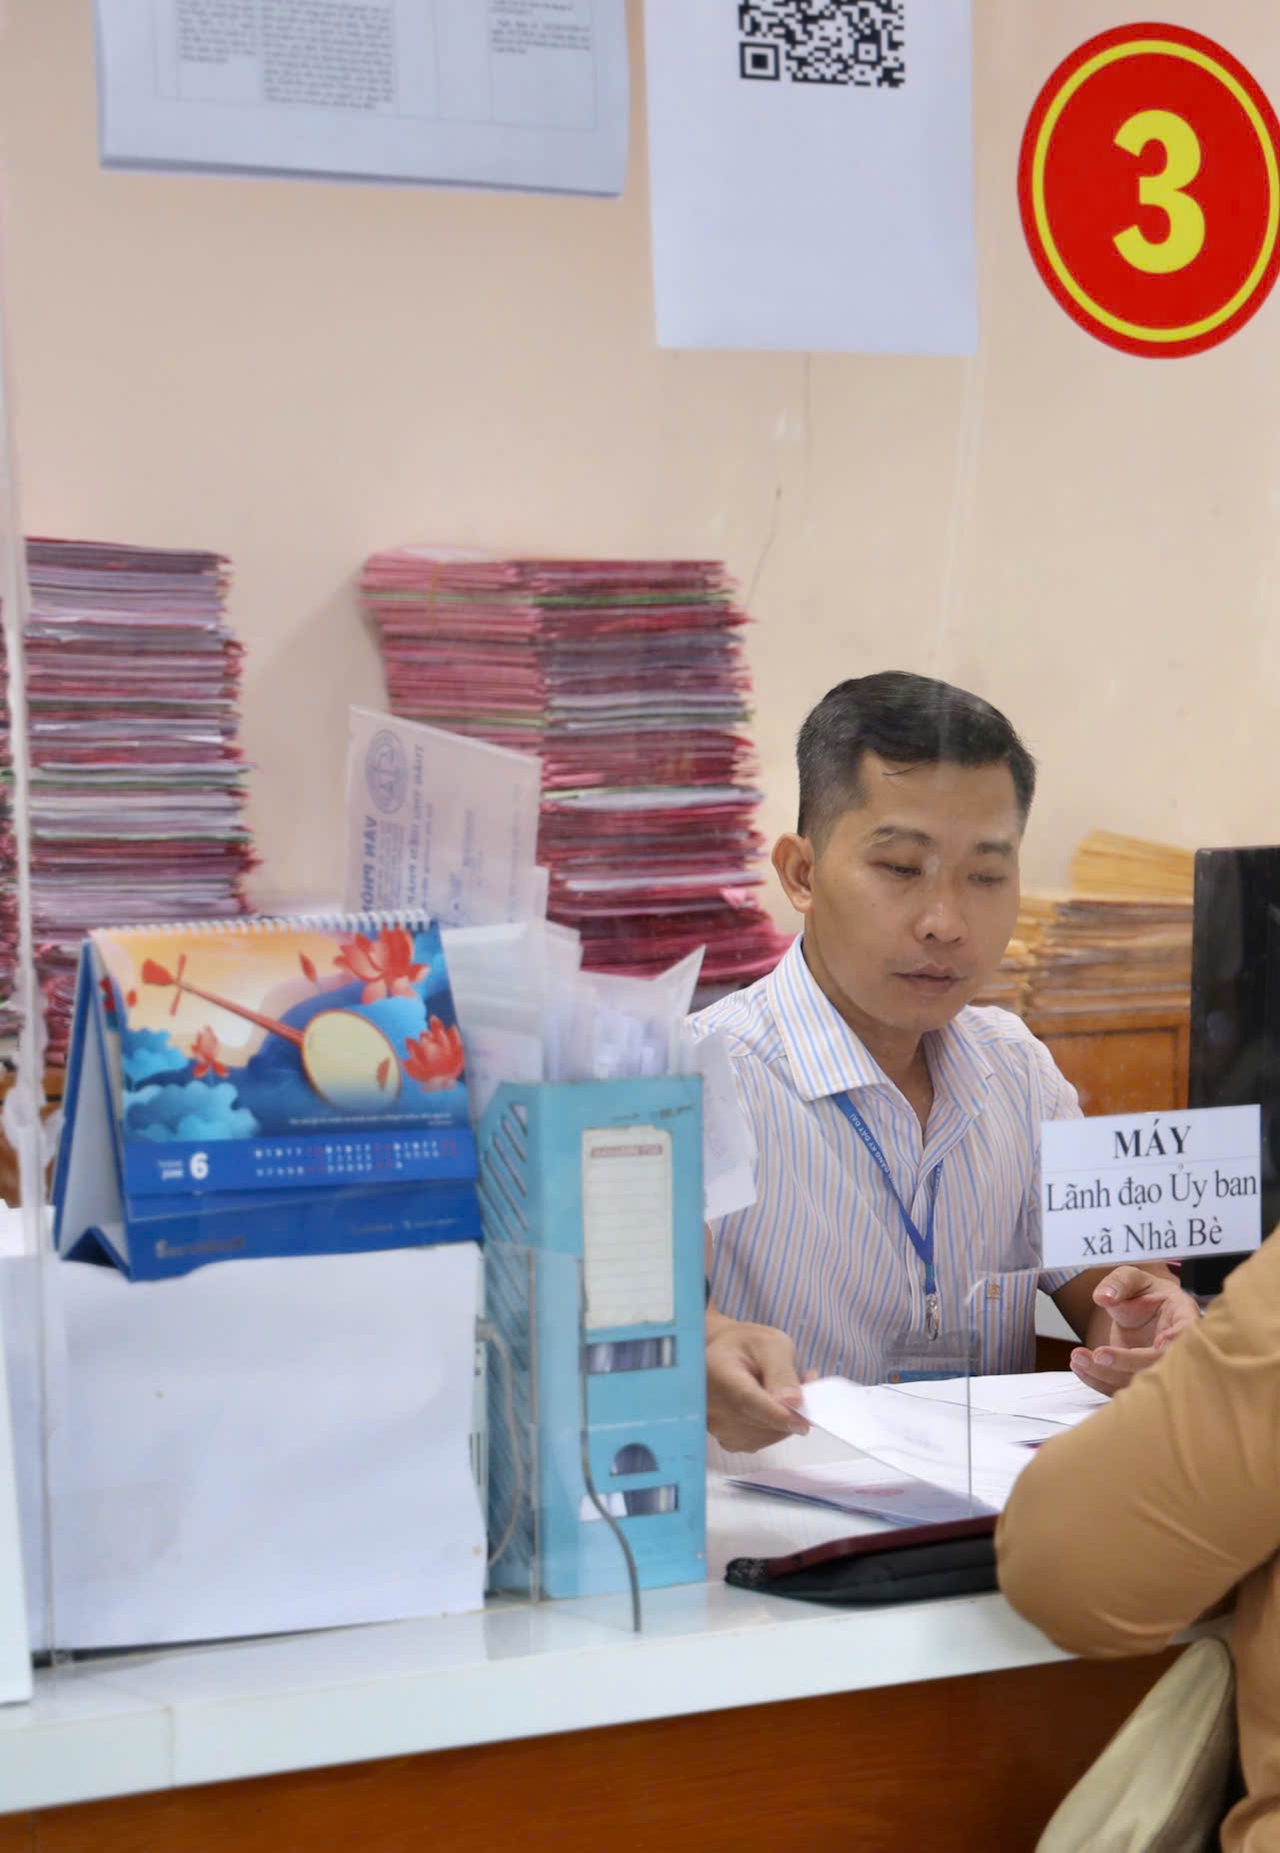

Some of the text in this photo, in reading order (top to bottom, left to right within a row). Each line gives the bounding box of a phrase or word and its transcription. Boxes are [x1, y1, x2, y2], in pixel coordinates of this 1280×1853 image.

[1113, 110, 1206, 274] 3
[1113, 1118, 1191, 1159] MÁY
[190, 1152, 209, 1180] 6
[1046, 1165, 1258, 1212] Lãnh đạo Ủy ban
[1082, 1216, 1223, 1257] xã Nhà Bè
